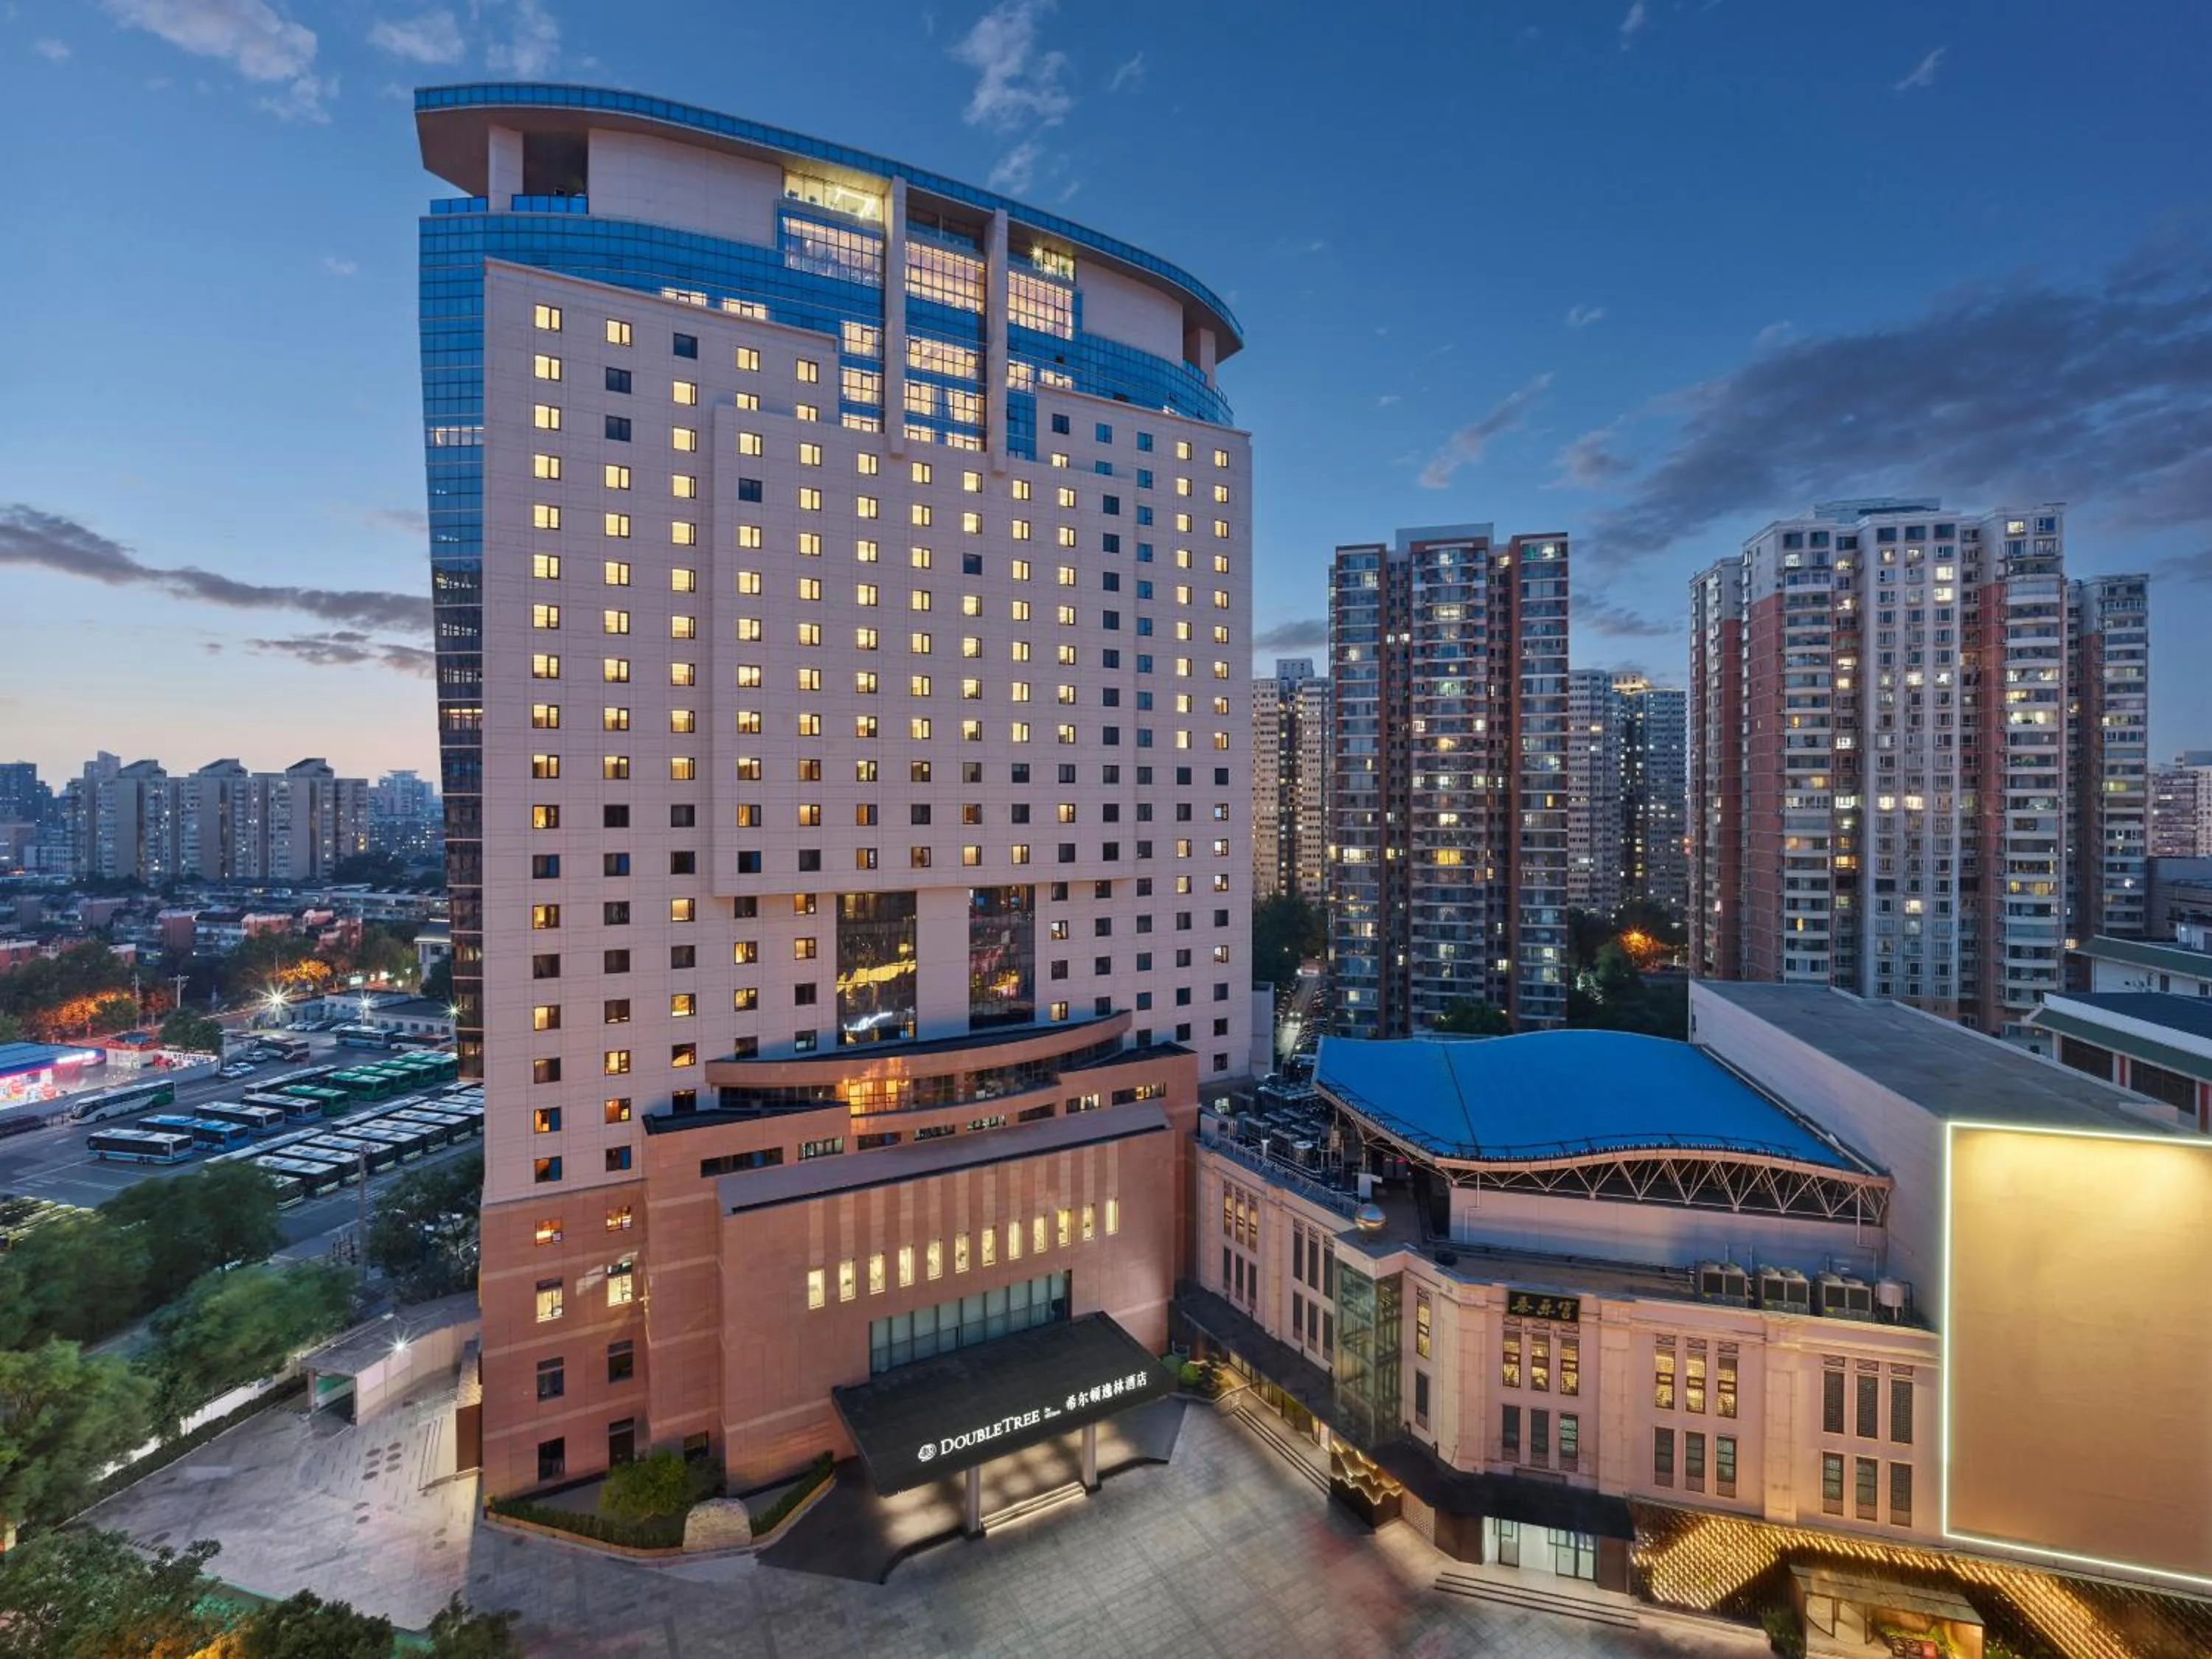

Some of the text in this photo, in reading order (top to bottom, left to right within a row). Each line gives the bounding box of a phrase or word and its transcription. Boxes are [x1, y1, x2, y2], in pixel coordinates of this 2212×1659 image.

[1066, 1371, 1147, 1411] 希尔顿逸林酒店
